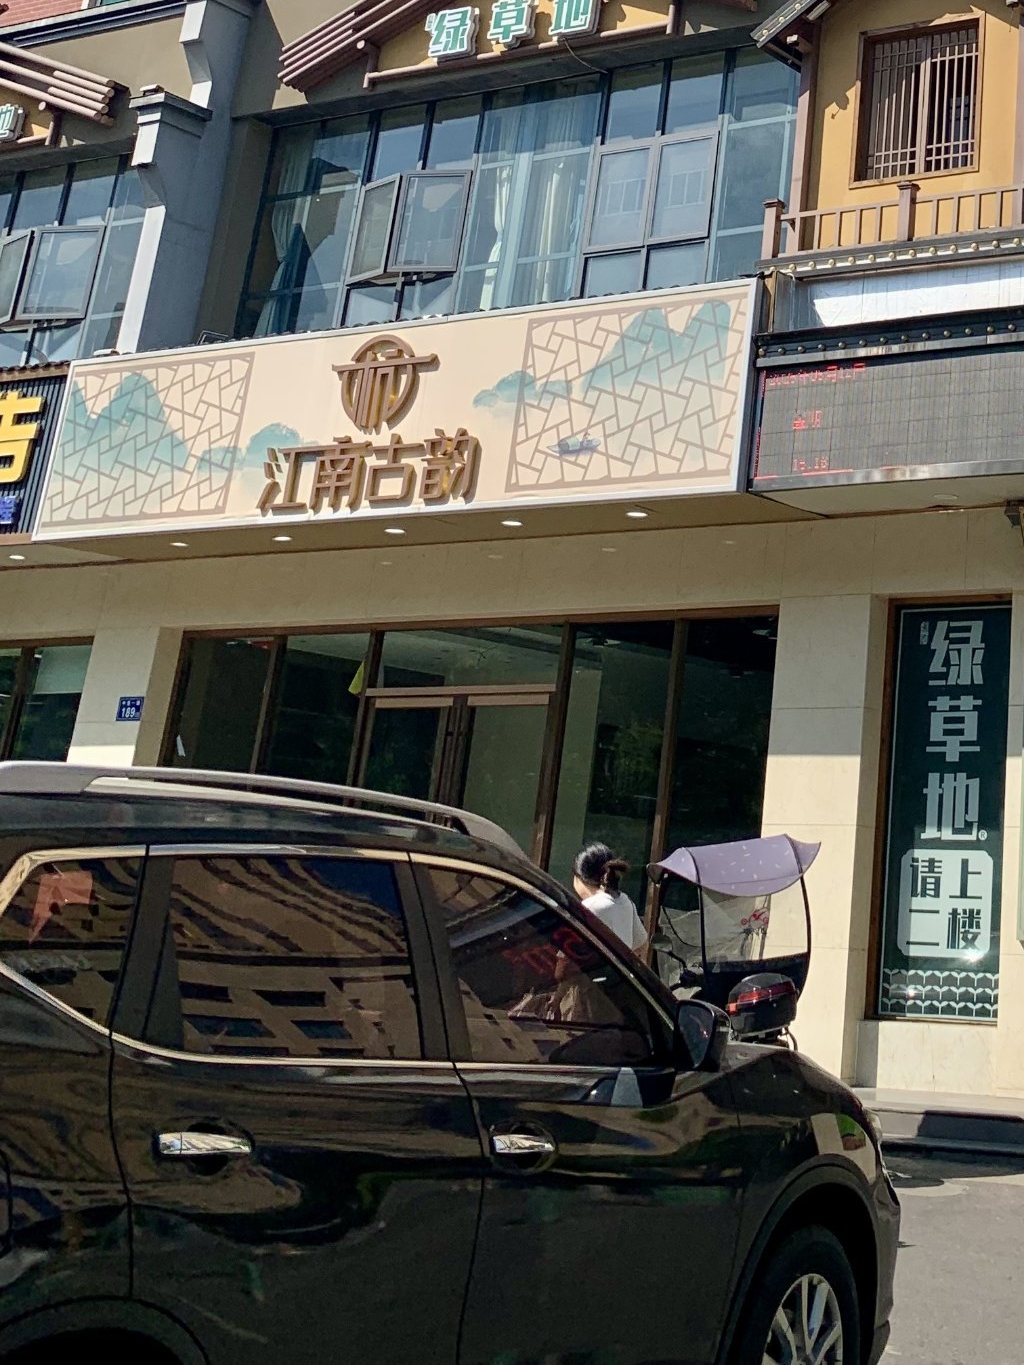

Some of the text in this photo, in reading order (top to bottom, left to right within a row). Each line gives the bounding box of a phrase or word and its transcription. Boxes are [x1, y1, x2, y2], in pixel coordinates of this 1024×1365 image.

[257, 428, 474, 509] 江南古韵
[927, 620, 986, 840] 绿草地
[909, 856, 983, 900] 请上
